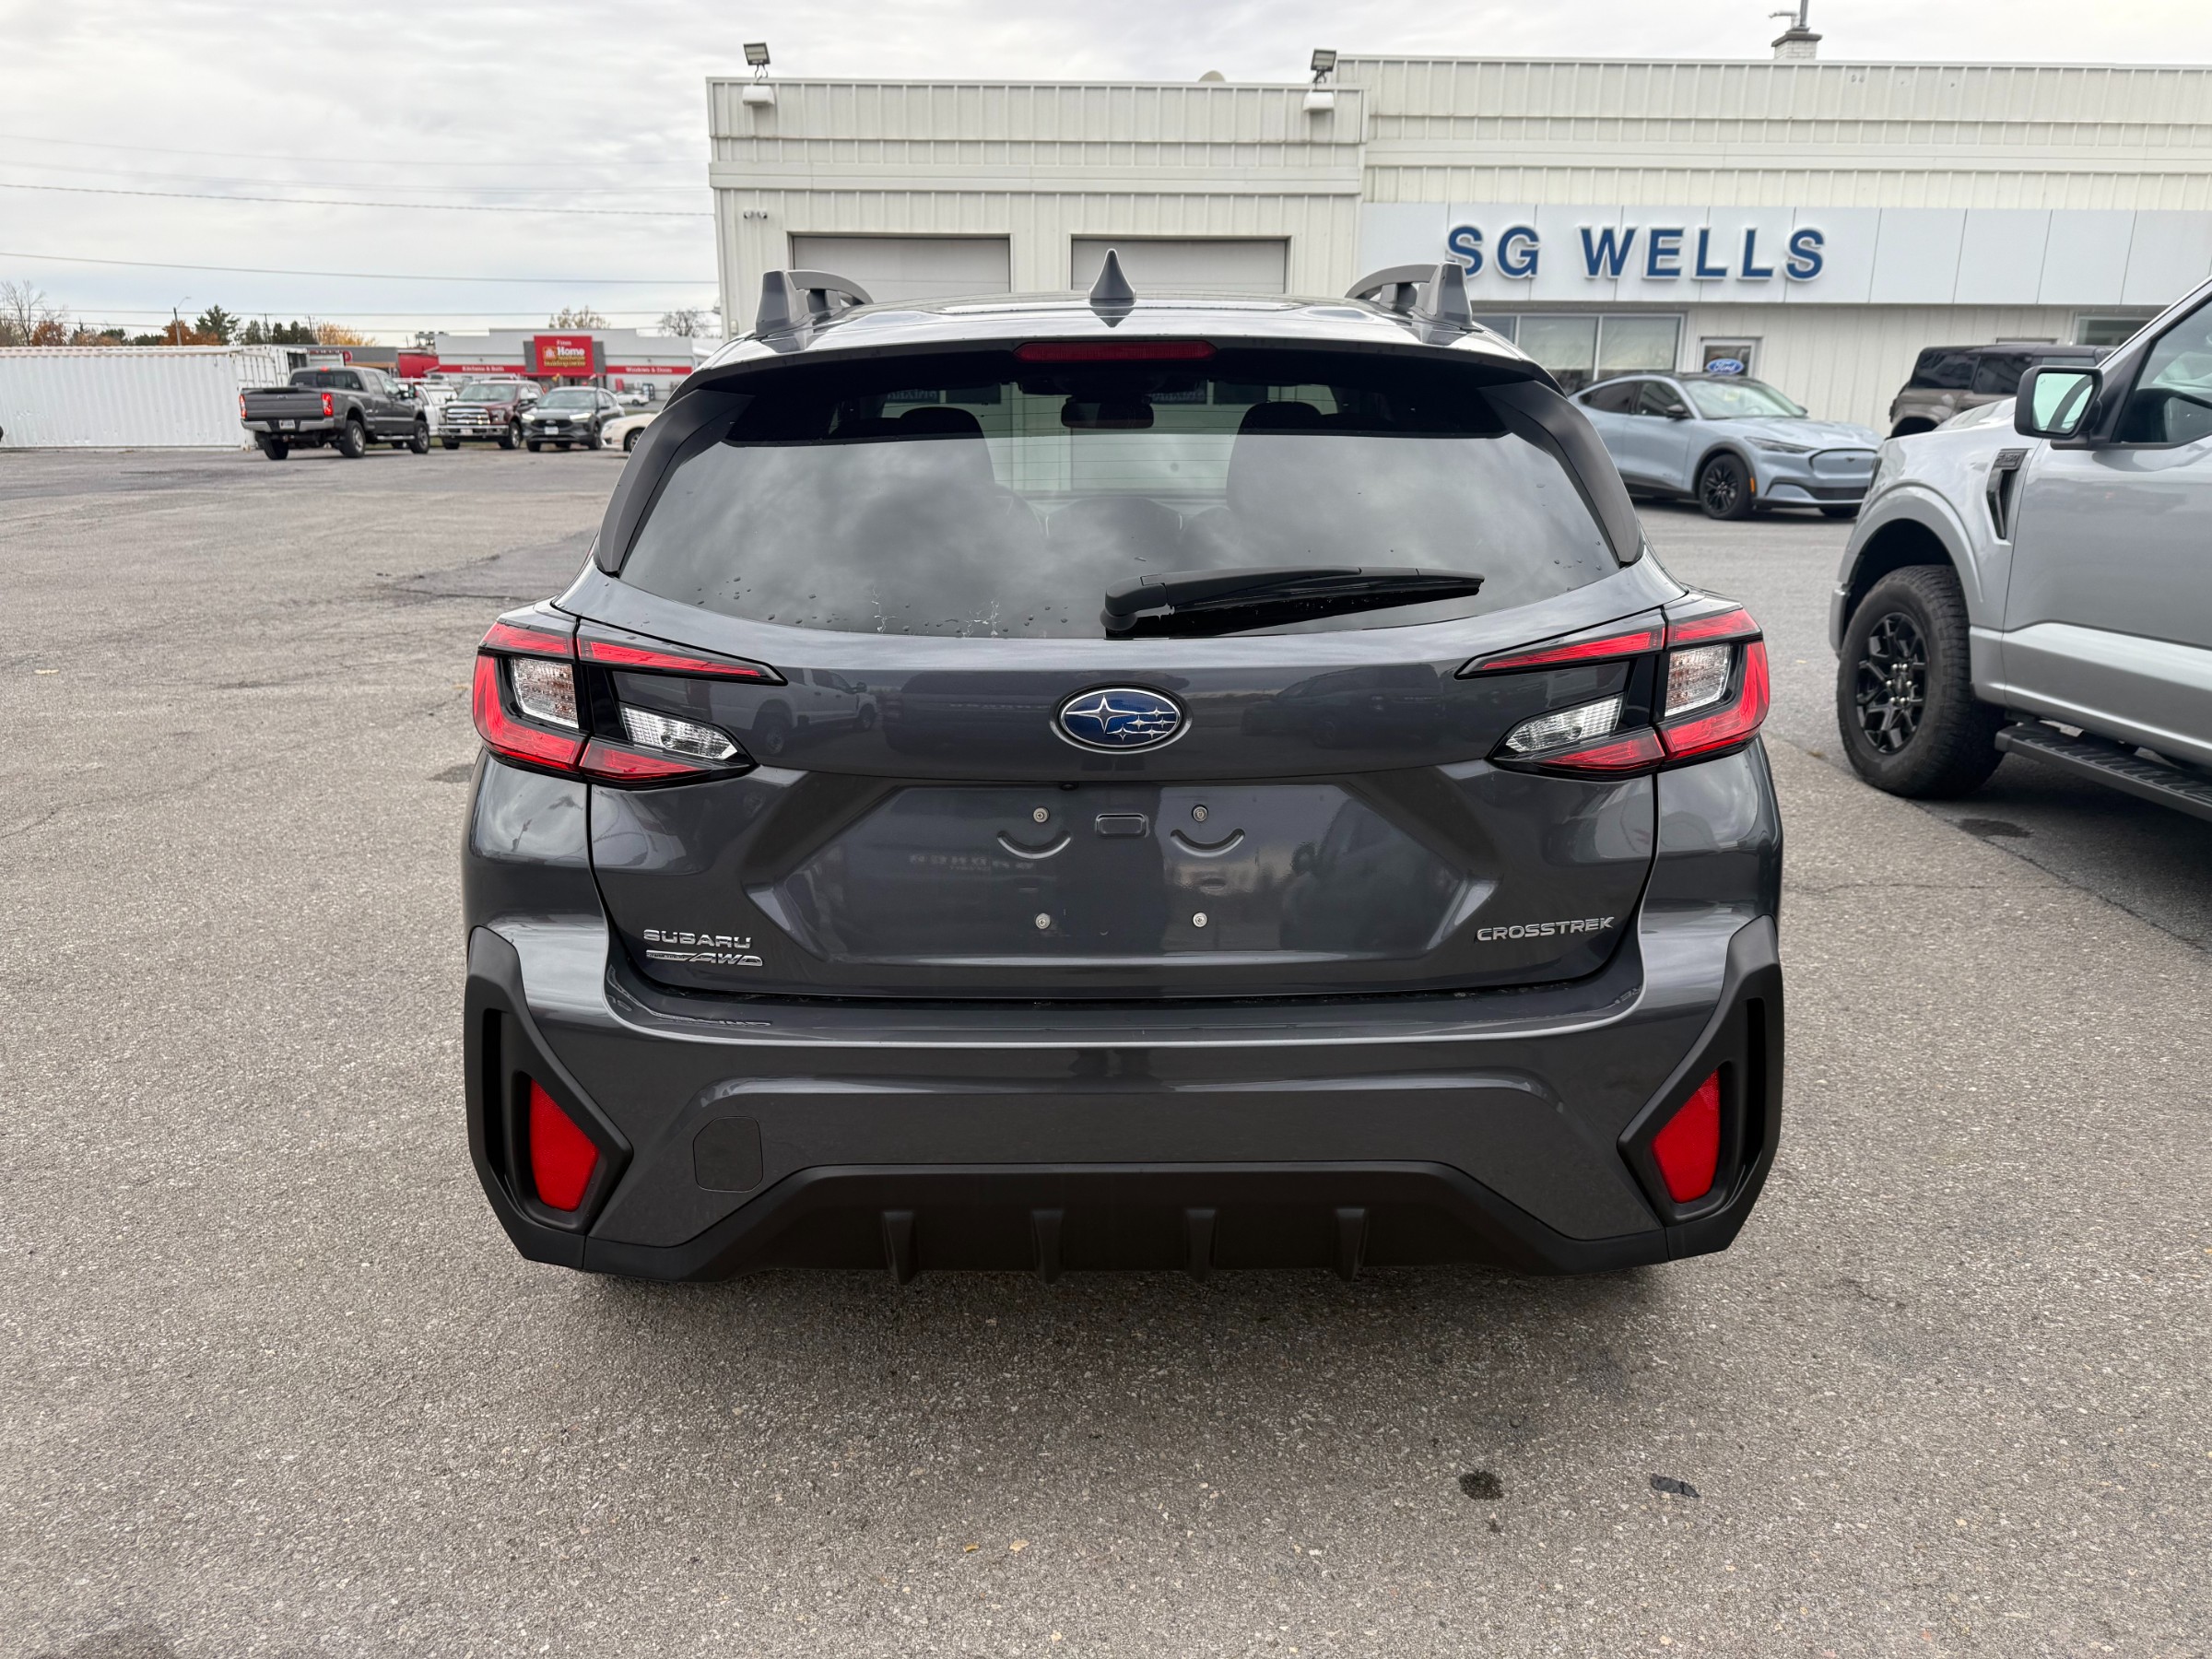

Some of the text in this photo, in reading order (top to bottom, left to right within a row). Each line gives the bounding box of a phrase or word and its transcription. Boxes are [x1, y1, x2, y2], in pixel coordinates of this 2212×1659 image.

[1446, 225, 1825, 279] SG WELLS
[558, 347, 585, 356] Home
[1712, 360, 1738, 372] Ford
[1477, 916, 1615, 941] CROSSTREK
[643, 928, 752, 948] SUBARU
[688, 952, 763, 967] AWD
